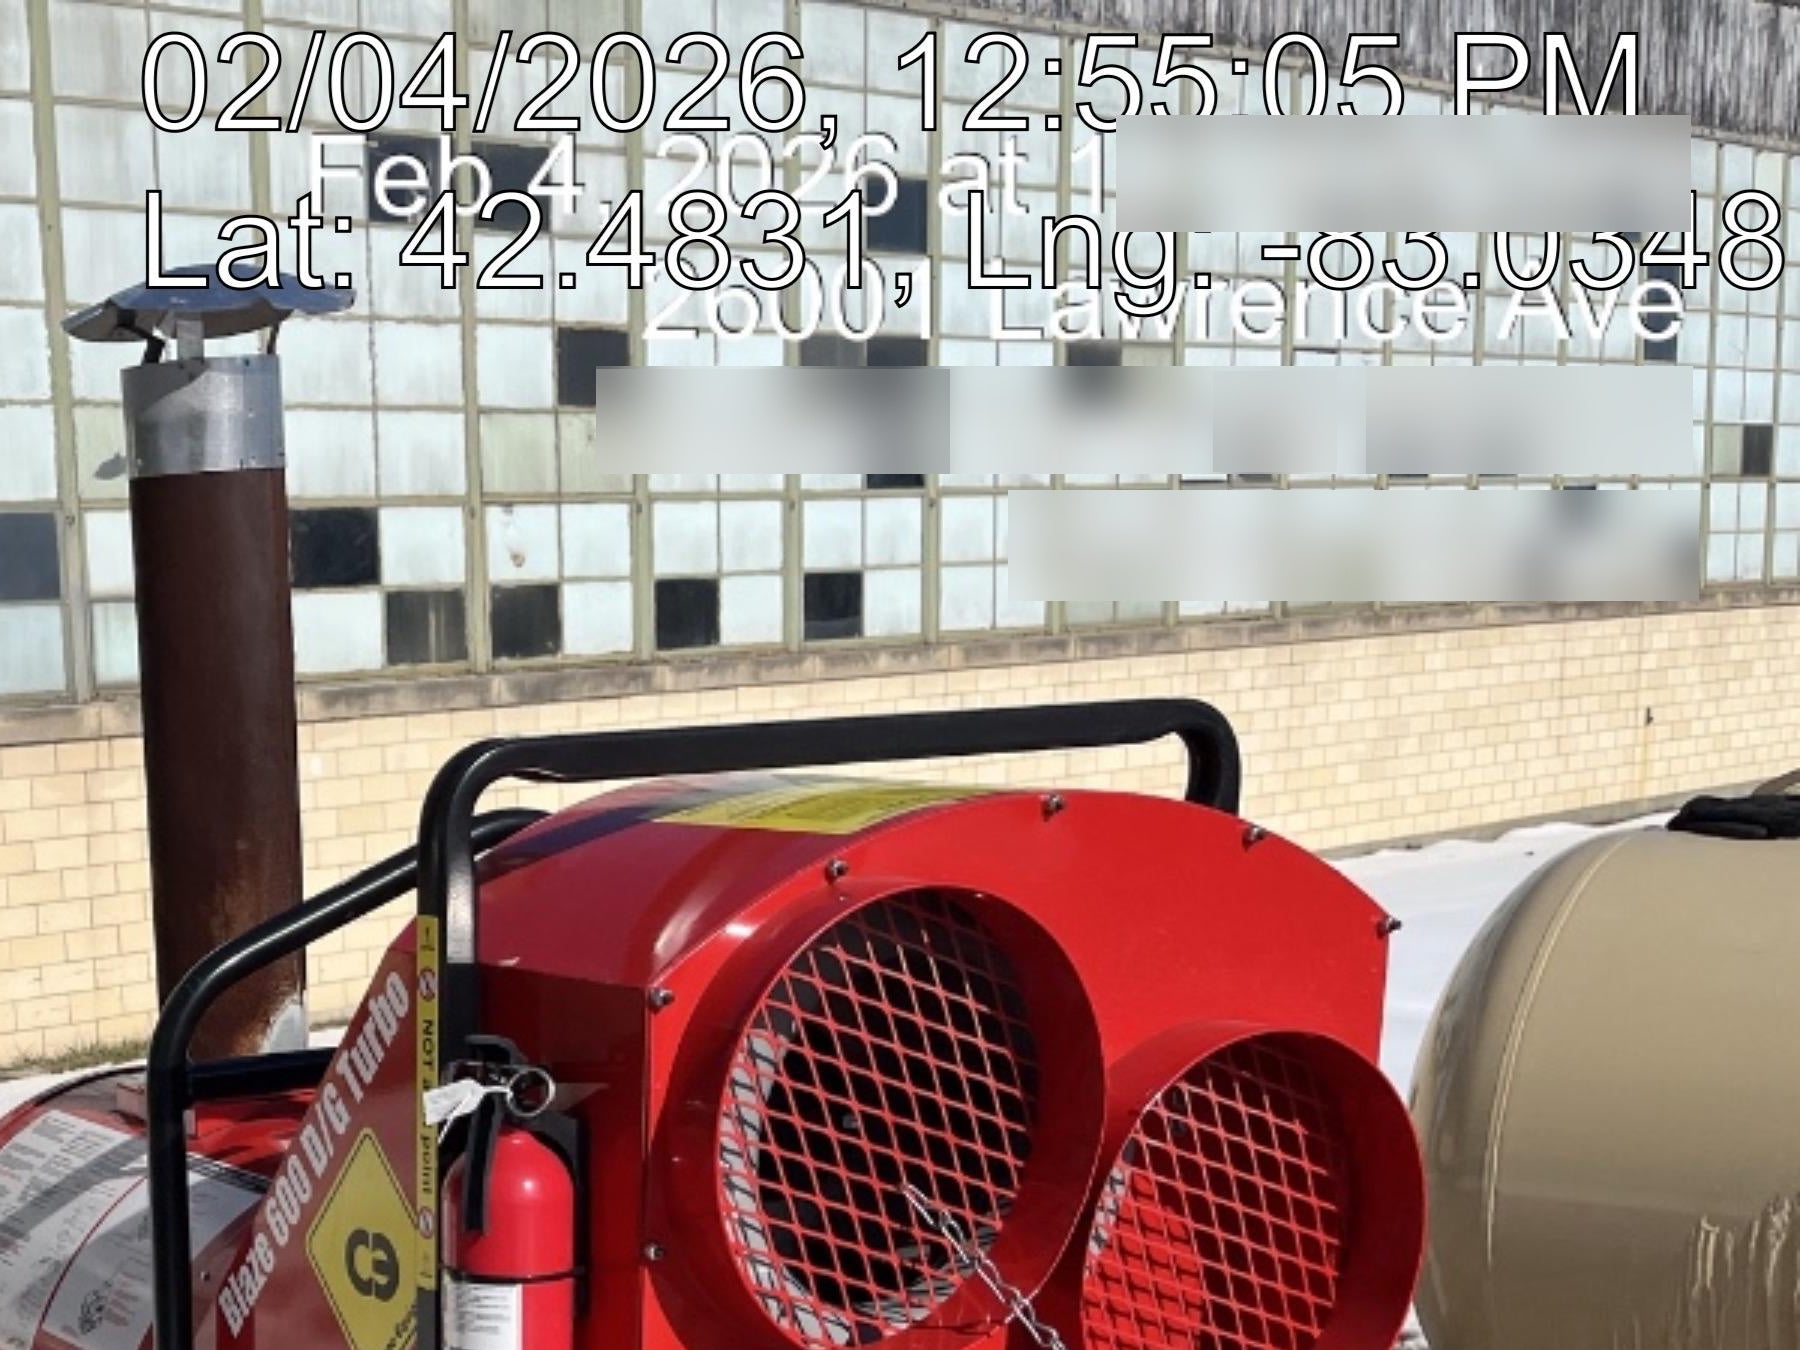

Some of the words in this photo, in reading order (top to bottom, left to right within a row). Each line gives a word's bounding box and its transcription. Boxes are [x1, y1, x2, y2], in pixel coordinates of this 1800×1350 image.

[422, 1018, 435, 1072] NOT
[217, 1231, 275, 1339] Blaze
[265, 1154, 315, 1248] 600
[300, 1082, 351, 1179] D/G
[336, 971, 410, 1104] Turbo
